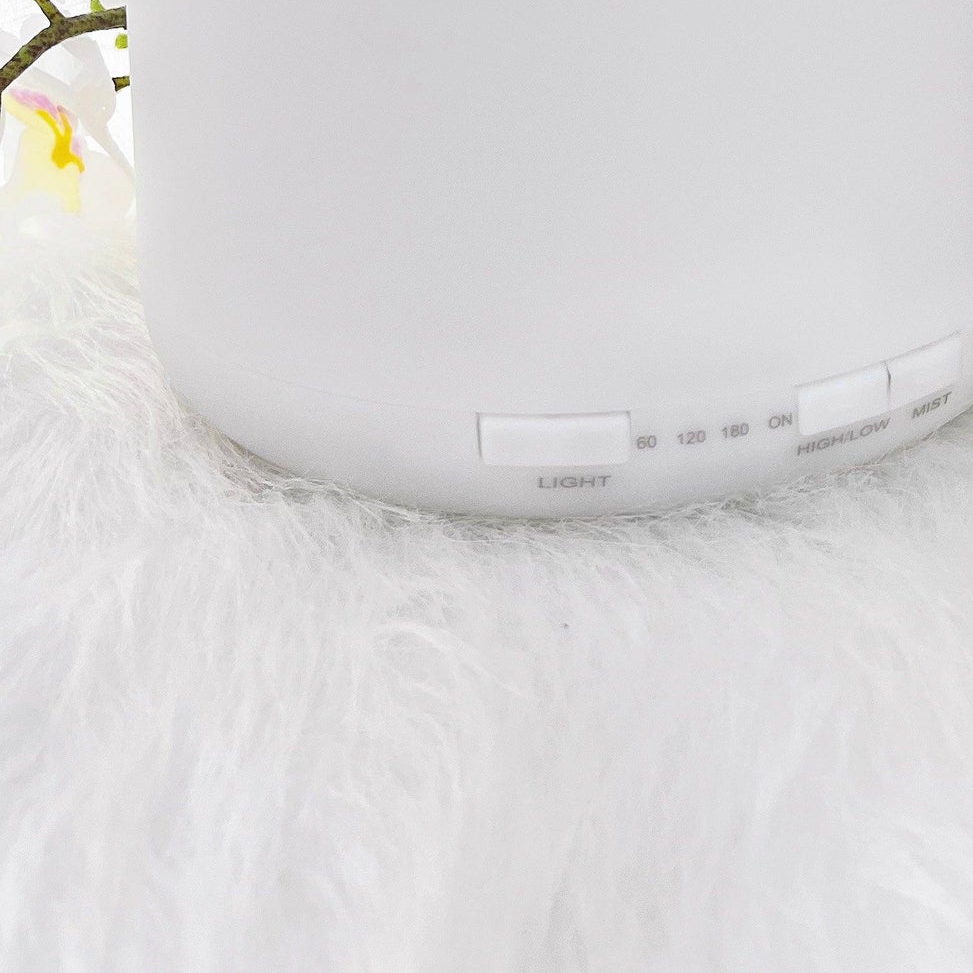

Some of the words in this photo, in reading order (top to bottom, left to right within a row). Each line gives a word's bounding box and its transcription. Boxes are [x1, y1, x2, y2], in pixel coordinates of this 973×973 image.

[636, 435, 657, 450] 60
[676, 430, 707, 445] 120
[721, 422, 750, 439] 180
[768, 412, 793, 429] ON
[797, 416, 892, 456] HIGH/LOW
[911, 391, 952, 419] MIST
[537, 475, 612, 489] LIGHT
